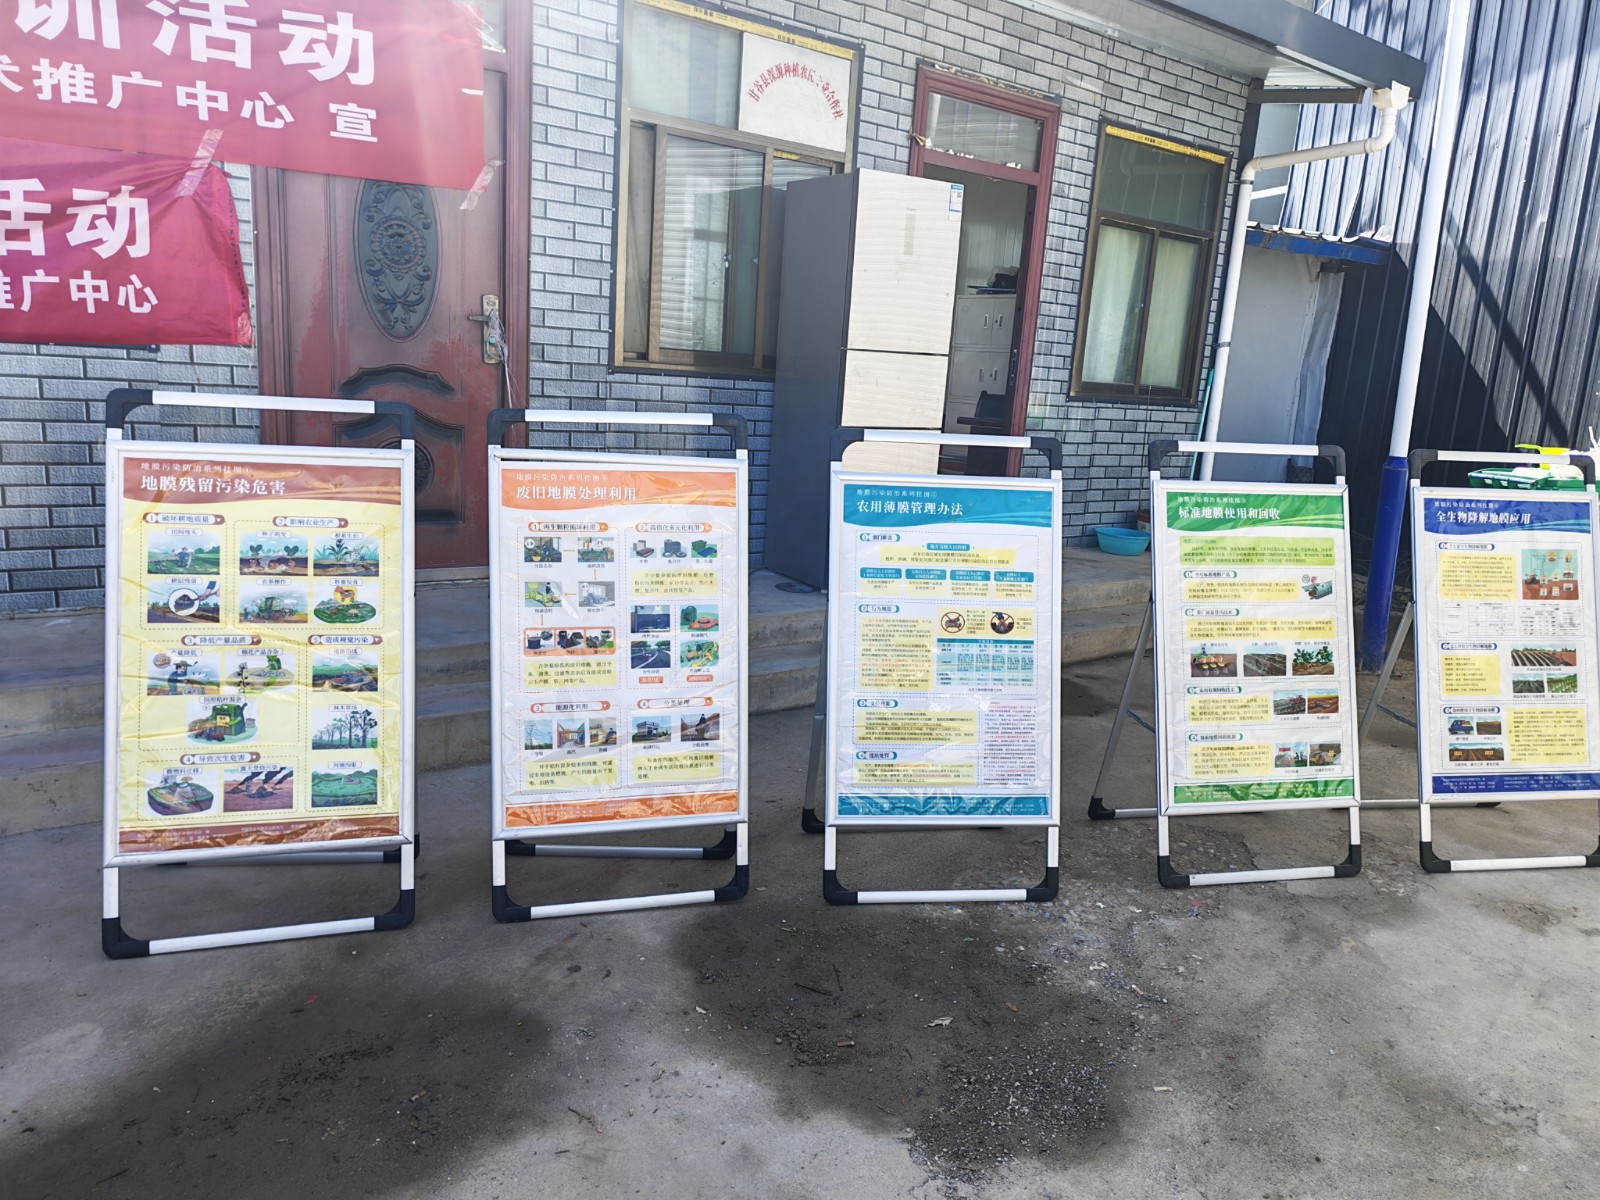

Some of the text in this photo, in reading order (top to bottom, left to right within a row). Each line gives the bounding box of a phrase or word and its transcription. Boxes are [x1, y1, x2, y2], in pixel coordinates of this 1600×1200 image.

[329, 102, 378, 143] 宣
[141, 475, 286, 496] 地膜残留污染危害
[516, 485, 637, 501] 废旧地膜处理利用
[856, 499, 964, 517] 农用薄膜管理办法
[1178, 506, 1281, 521] 标准地膜使用和回收
[1436, 510, 1532, 525] 全生物降解地膜应用
[199, 635, 247, 645] 降低产量品质
[324, 635, 369, 644] 造成视觉污染
[198, 754, 246, 763] 导致次生危害
